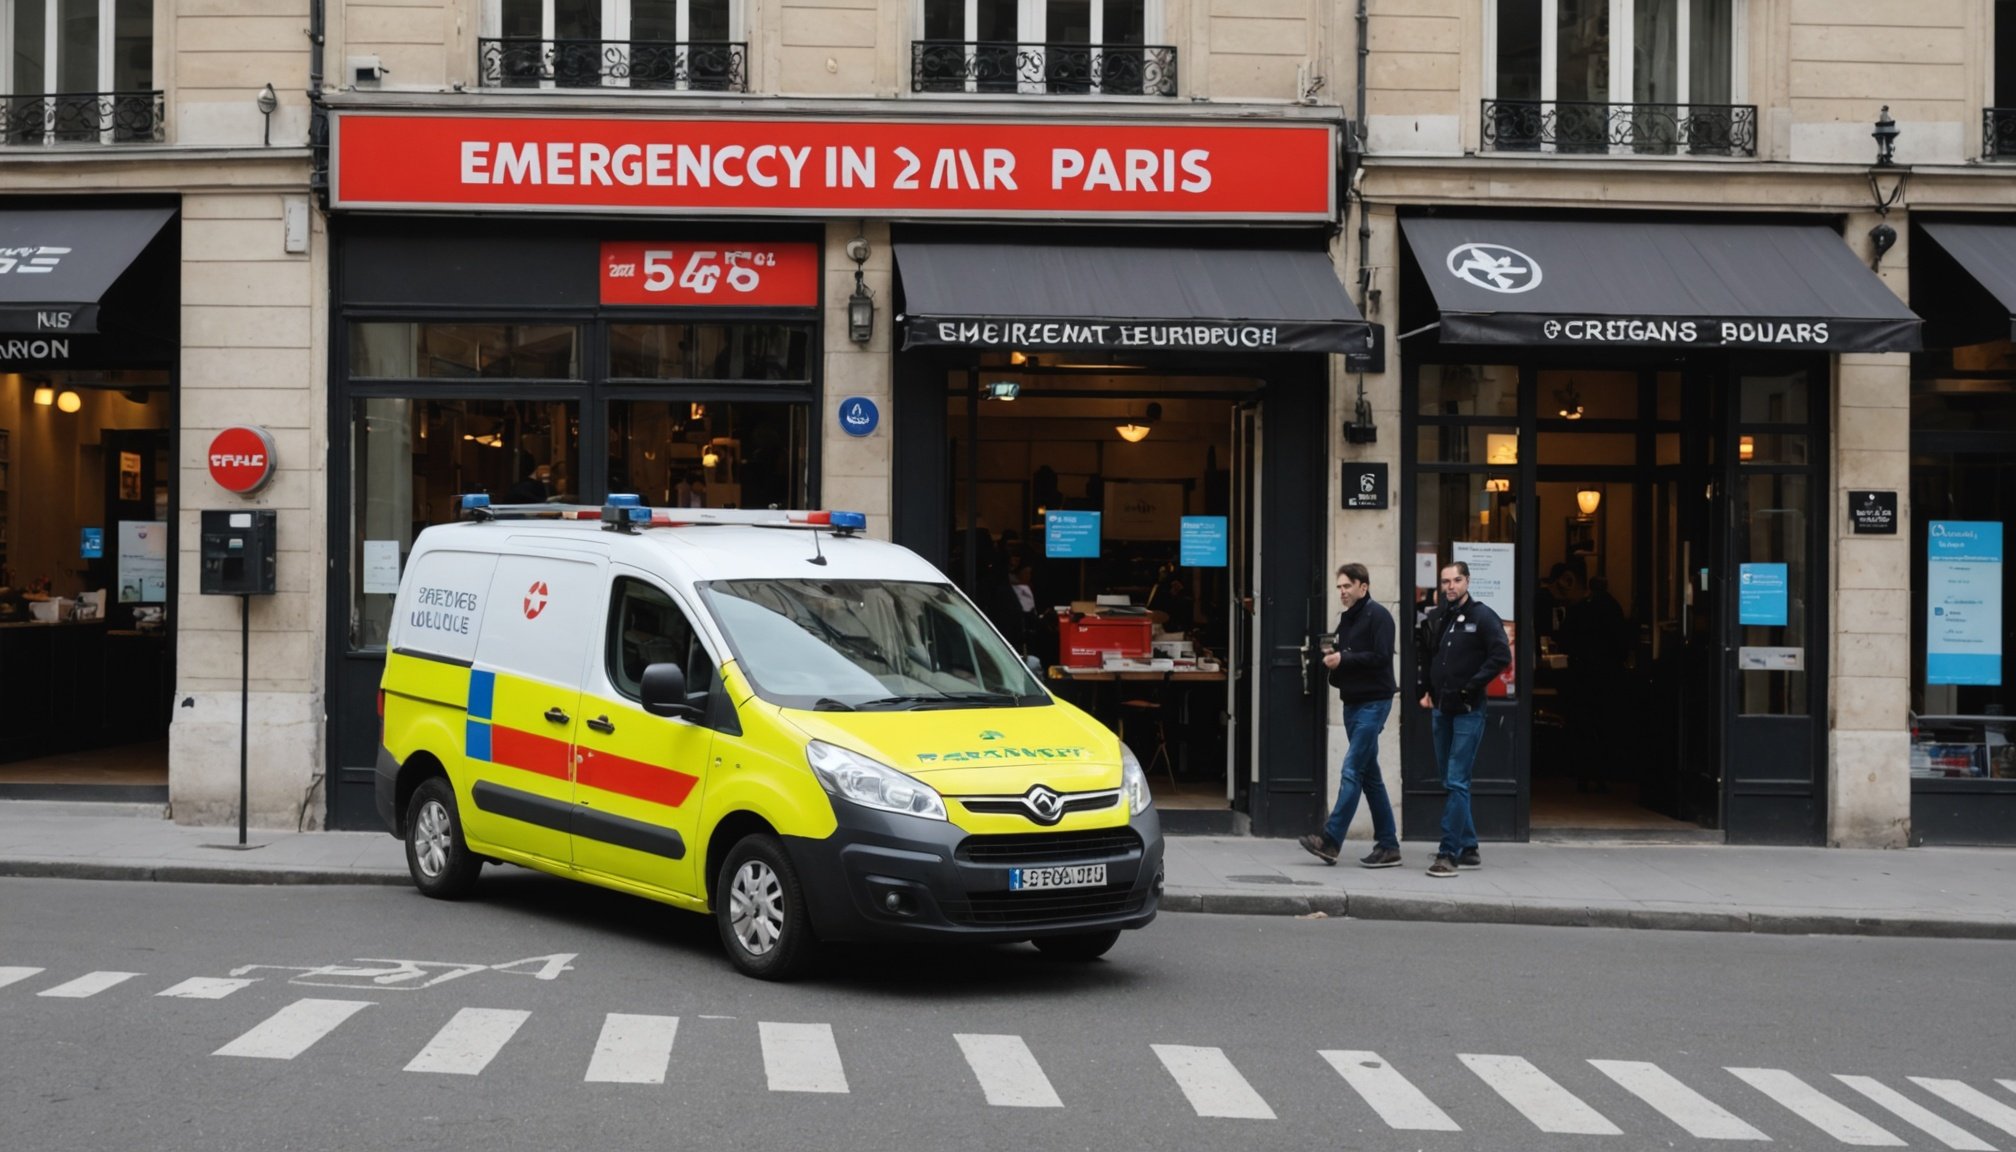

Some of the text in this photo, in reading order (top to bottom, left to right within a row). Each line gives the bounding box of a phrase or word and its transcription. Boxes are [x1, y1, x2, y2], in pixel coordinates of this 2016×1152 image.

[460, 141, 812, 188] EMERGENCCY
[825, 145, 875, 188] IN
[1051, 148, 1213, 193] PARIS
